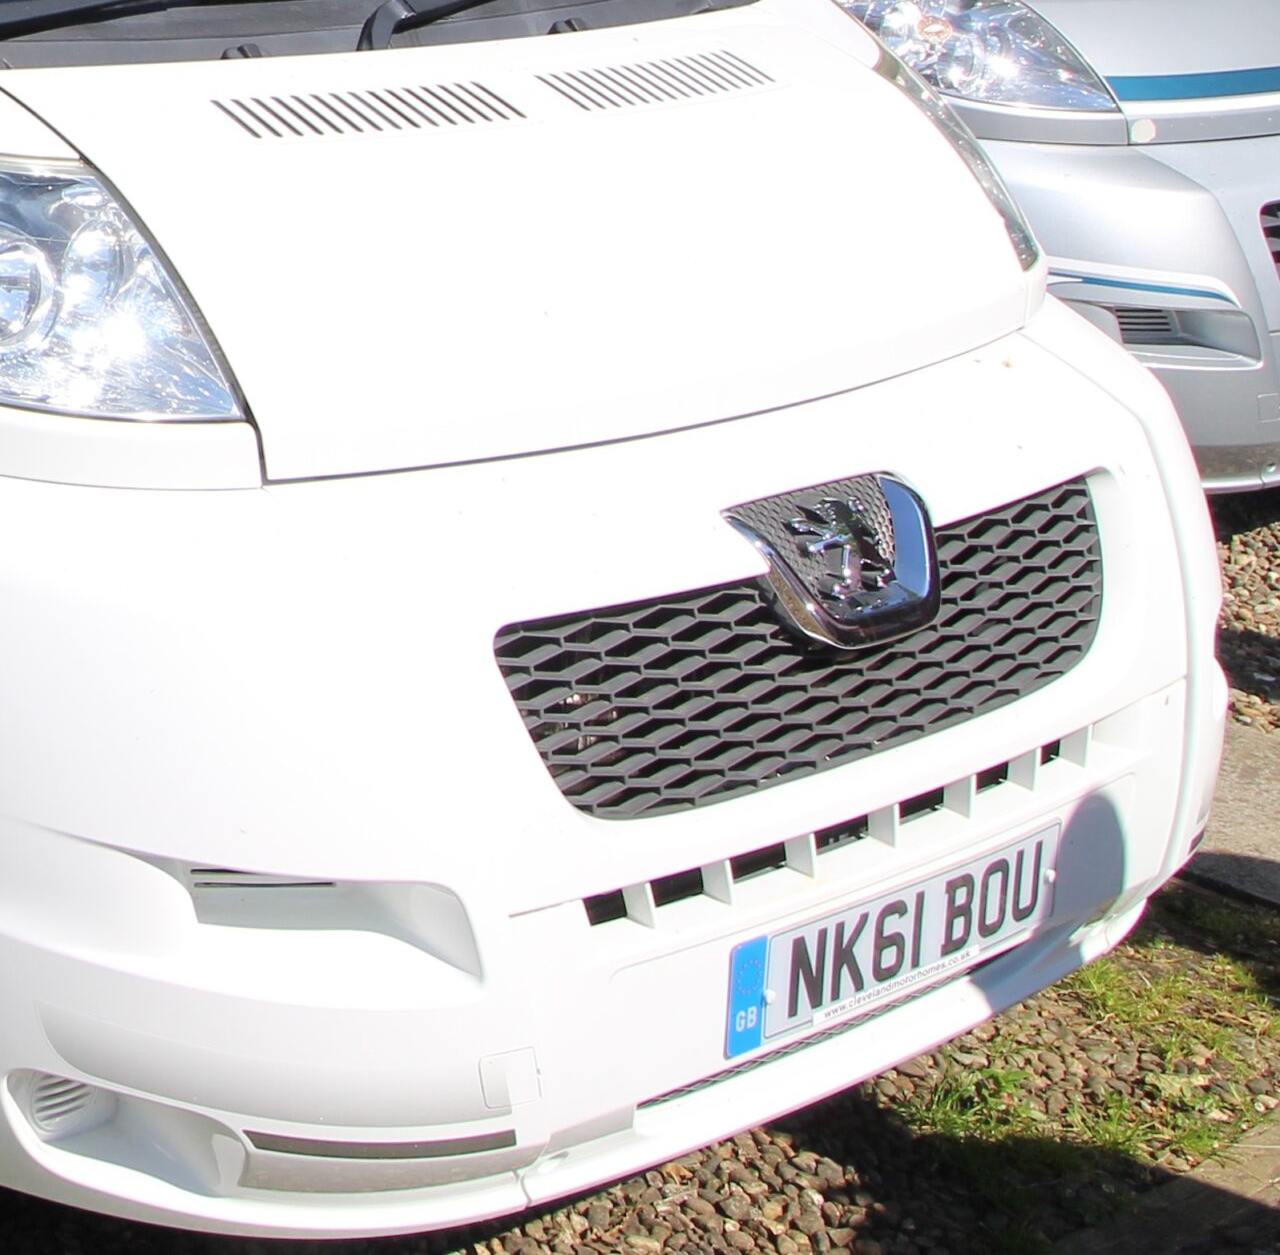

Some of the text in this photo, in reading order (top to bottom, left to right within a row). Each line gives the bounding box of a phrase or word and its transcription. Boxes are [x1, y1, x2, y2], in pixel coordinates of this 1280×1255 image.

[786, 839, 1044, 1020] NK61 BOU
[735, 1005, 758, 1033] GB
[824, 950, 971, 1019] www.clevelandmotorhomes.co.uk
